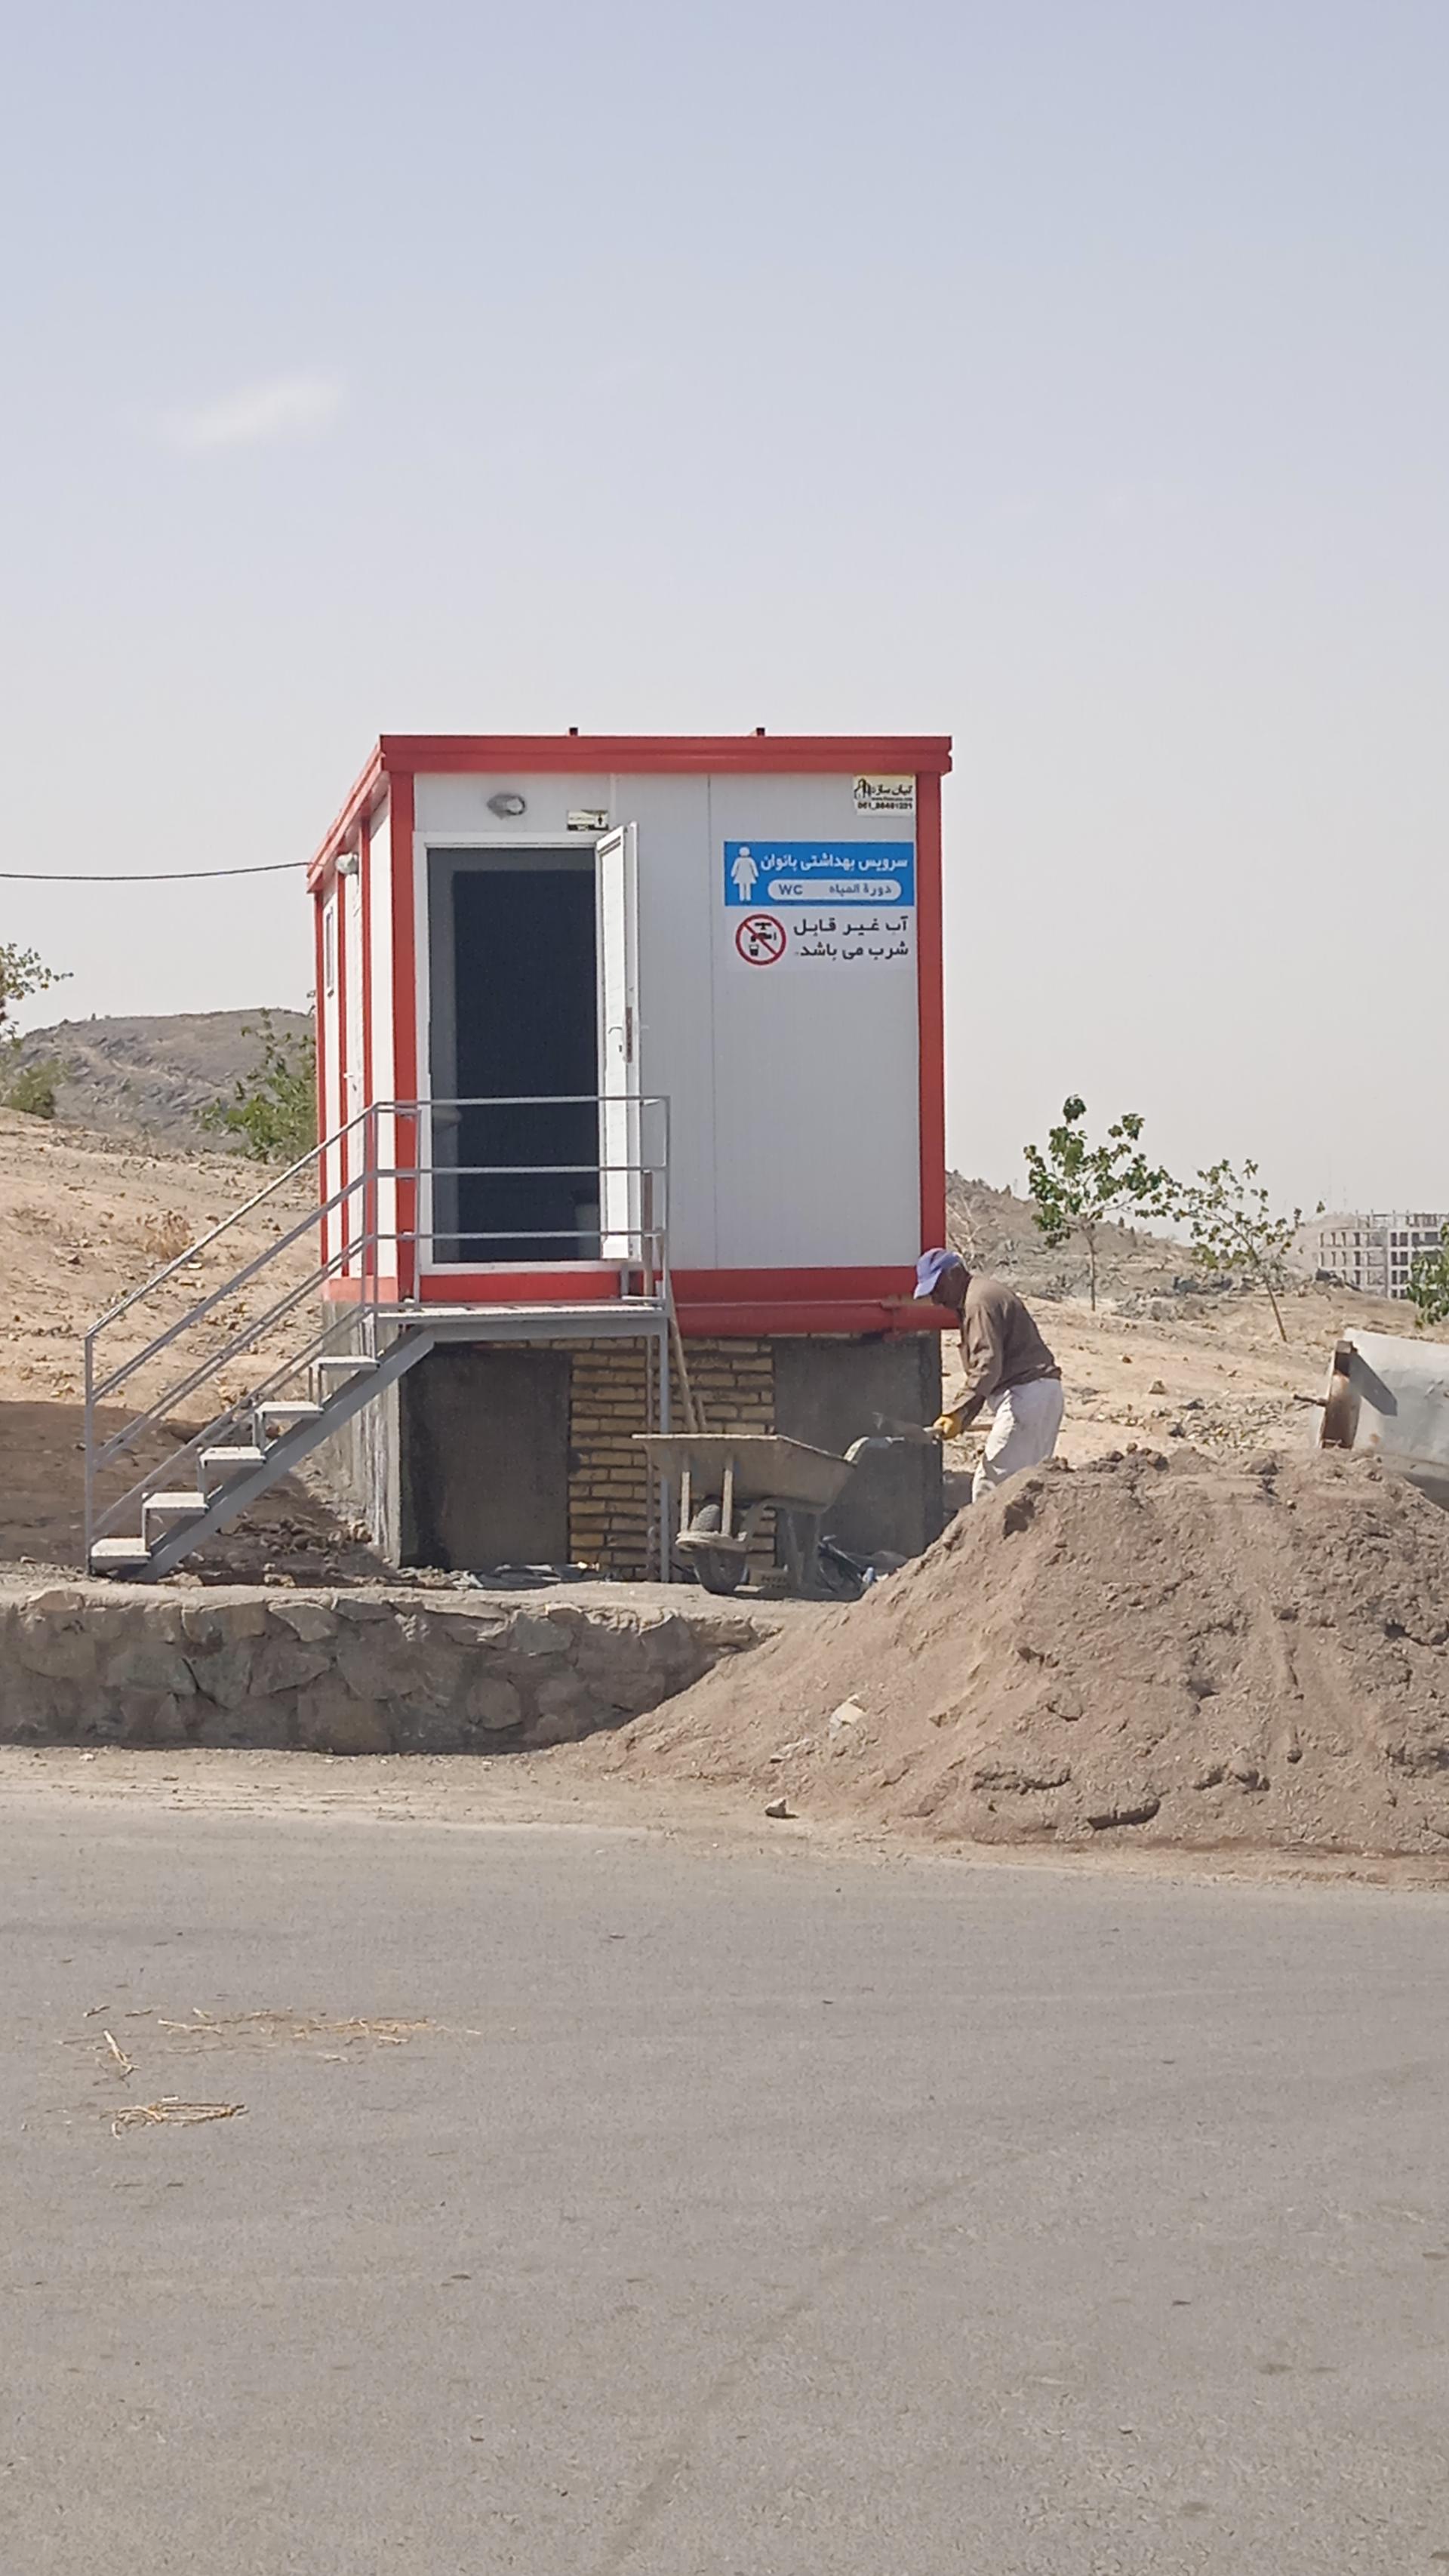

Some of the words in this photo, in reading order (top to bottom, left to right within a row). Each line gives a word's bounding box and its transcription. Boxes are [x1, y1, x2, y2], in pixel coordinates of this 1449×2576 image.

[760, 853, 798, 872] بانوان
[800, 852, 855, 872] بهداشتی
[858, 855, 908, 872] سرویس
[778, 884, 804, 896] WC
[793, 916, 837, 937] قابل
[842, 916, 879, 936] غیر
[885, 916, 909, 935] آب
[841, 947, 864, 961] می
[868, 940, 909, 961] شرب
